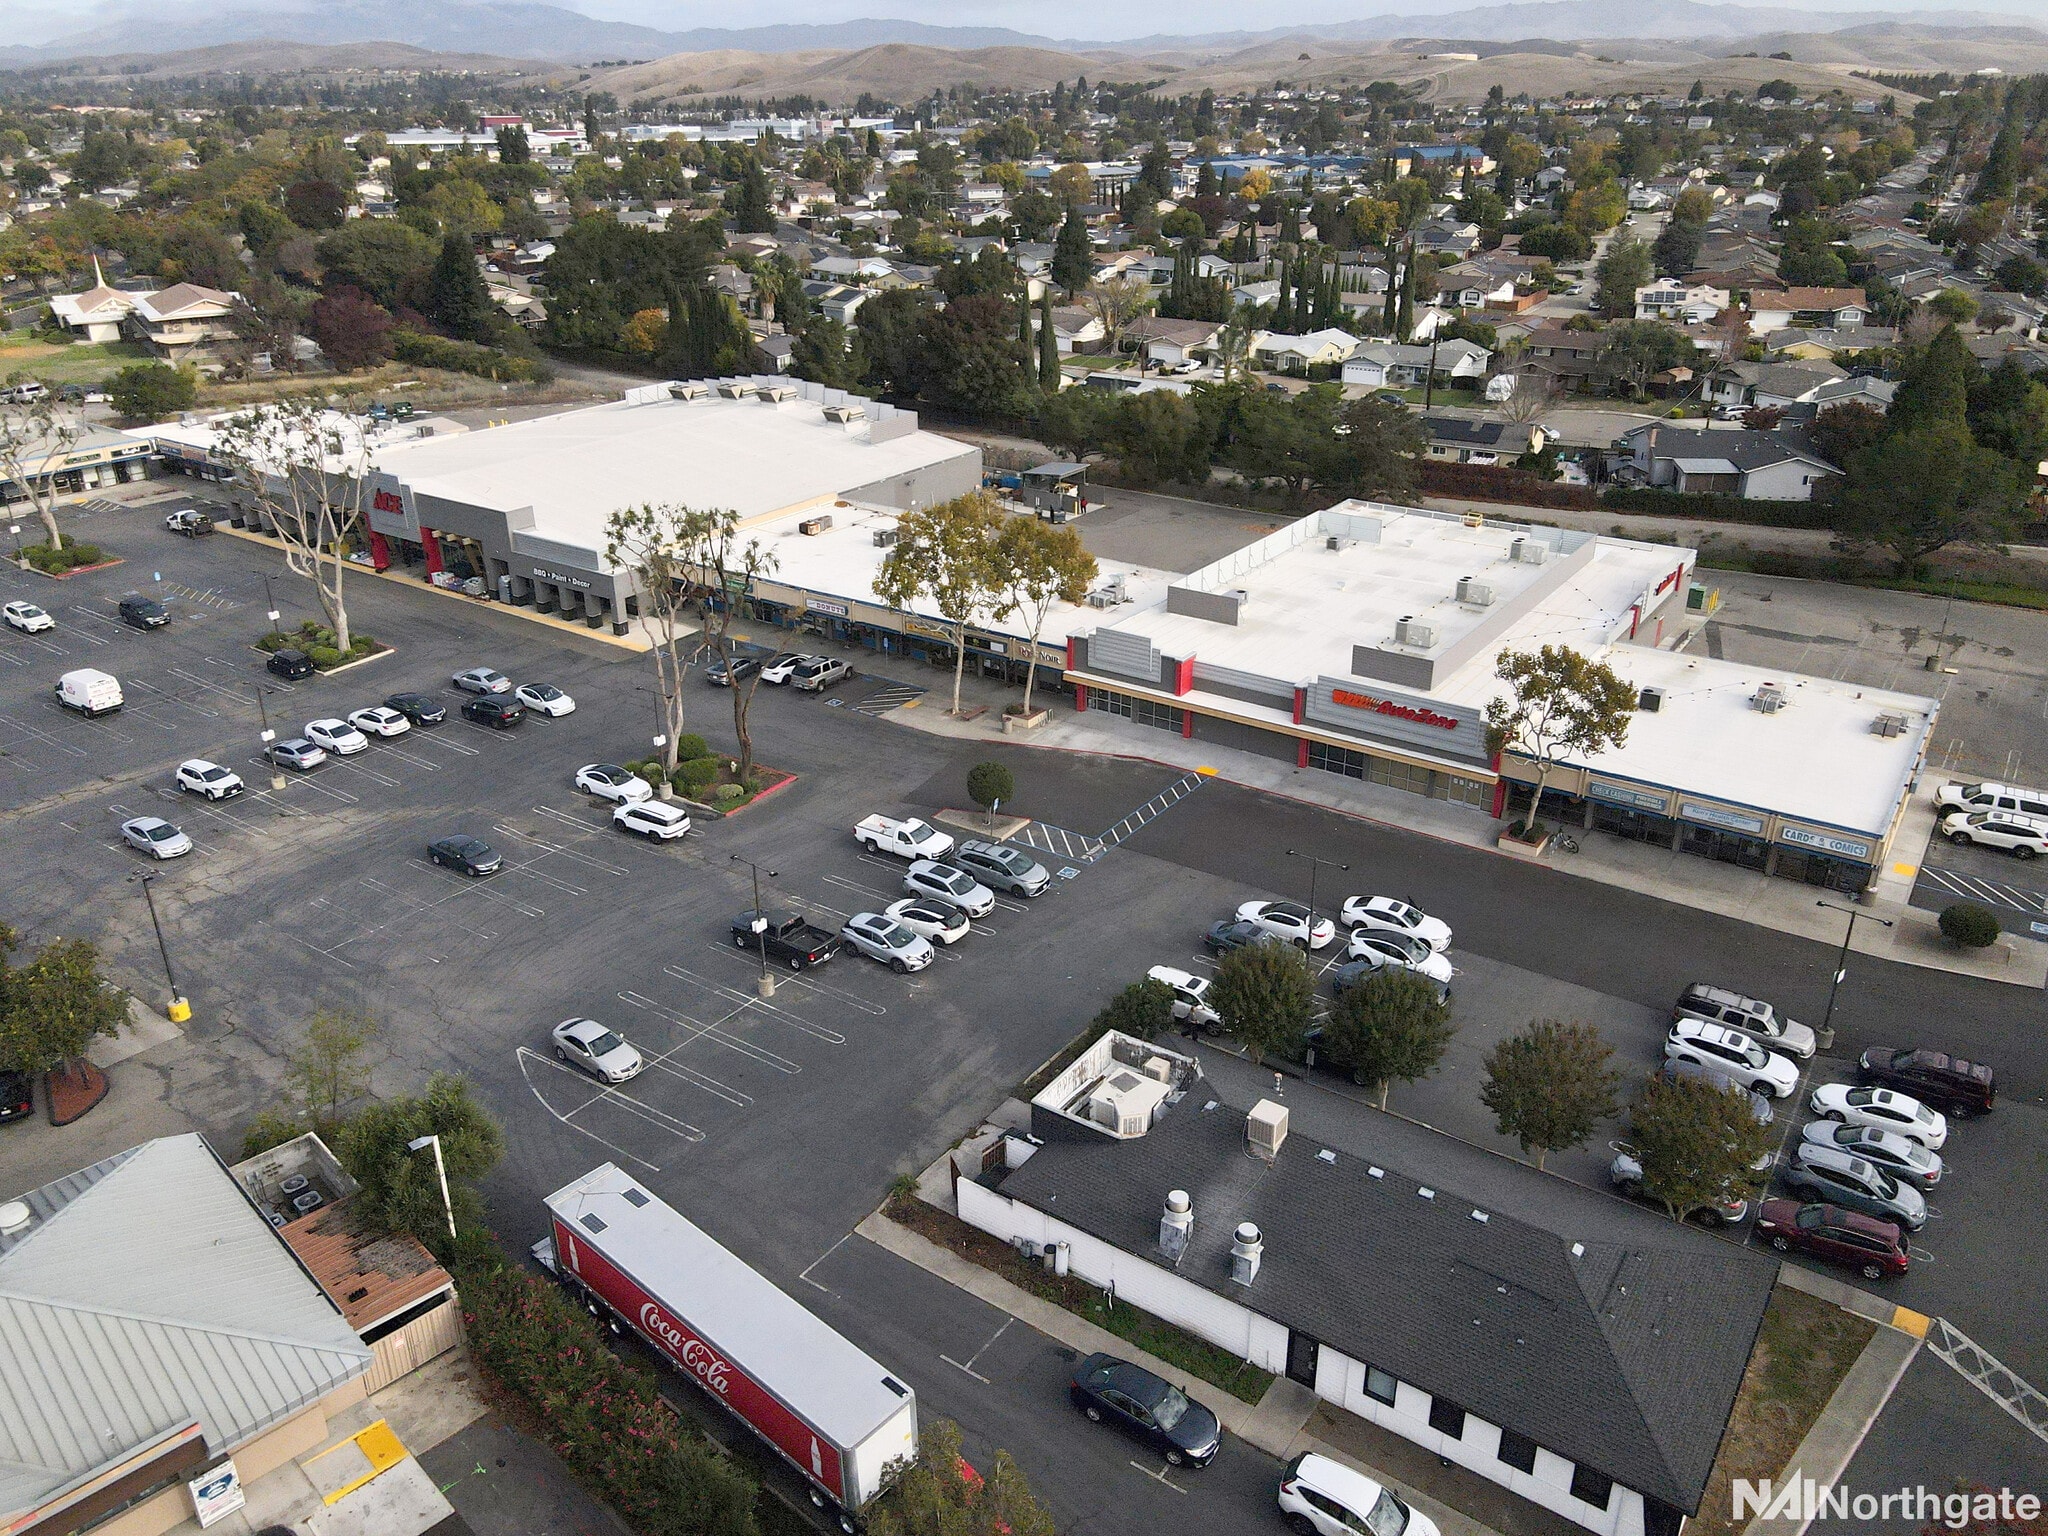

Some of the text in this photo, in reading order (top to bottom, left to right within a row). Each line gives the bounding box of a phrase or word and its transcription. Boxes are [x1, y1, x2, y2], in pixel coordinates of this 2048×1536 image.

[373, 487, 404, 515] ACE
[533, 567, 591, 589] BBQ Paint Decor
[816, 602, 845, 614] DONUTS
[1376, 700, 1459, 730] AutoZone
[1785, 830, 1815, 844] CARDS
[1829, 840, 1865, 856] COMICS
[640, 1302, 731, 1394] Coca-Cola
